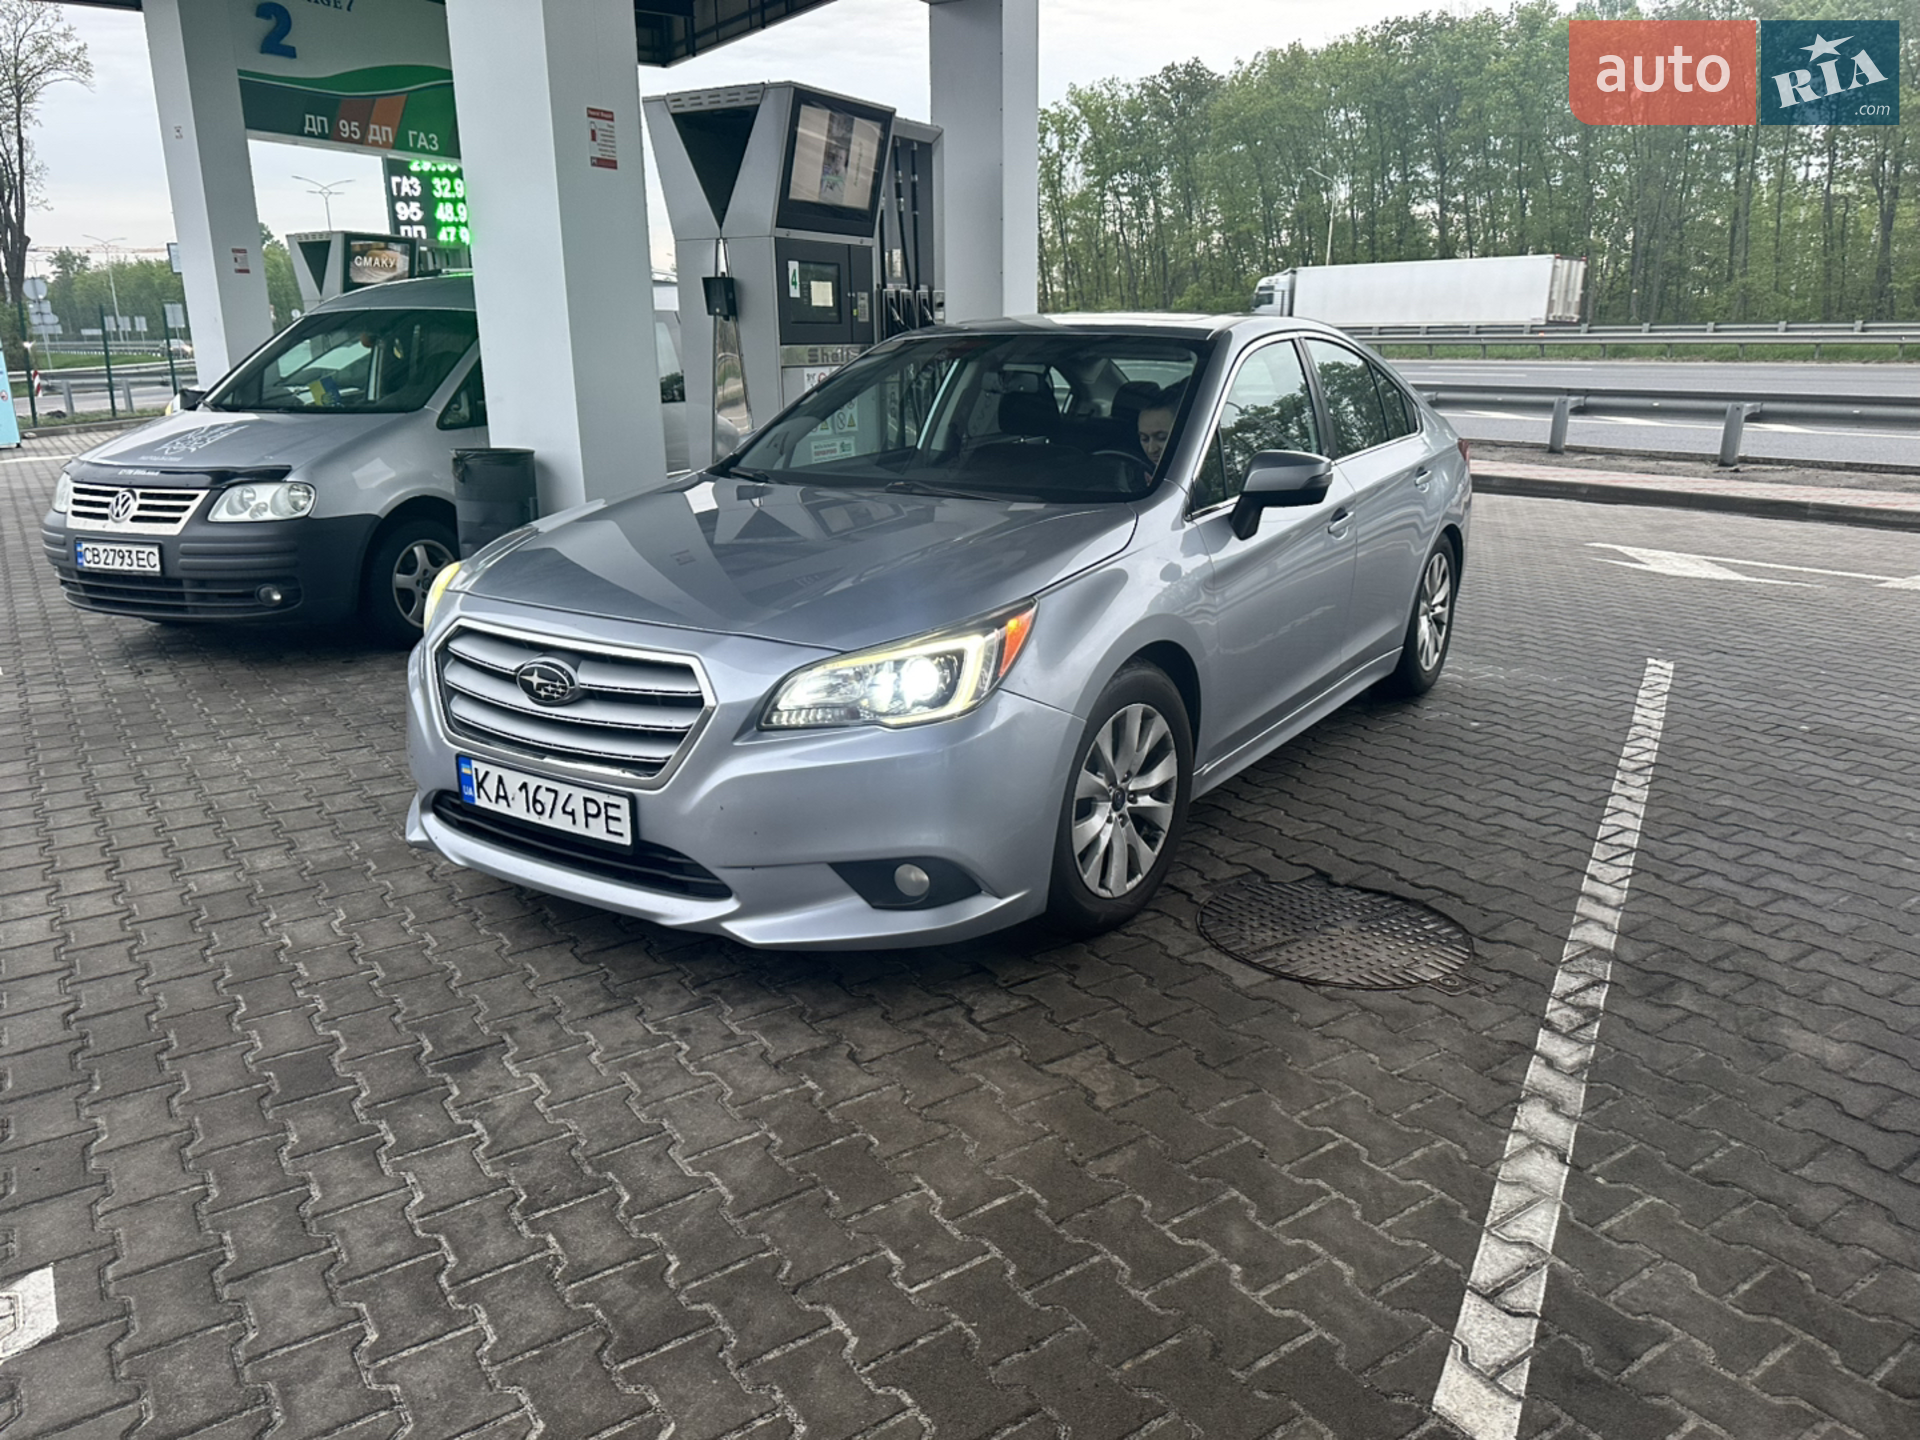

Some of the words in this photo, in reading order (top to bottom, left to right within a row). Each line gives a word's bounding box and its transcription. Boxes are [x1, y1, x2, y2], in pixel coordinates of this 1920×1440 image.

[255, 2, 297, 59] 2
[304, 114, 329, 135] ДП
[339, 120, 361, 139] 95
[368, 124, 393, 144] ДП
[408, 130, 440, 151] ГАЗ
[391, 175, 421, 197] ГАЗ
[395, 201, 423, 221] 95
[791, 268, 798, 290] 4
